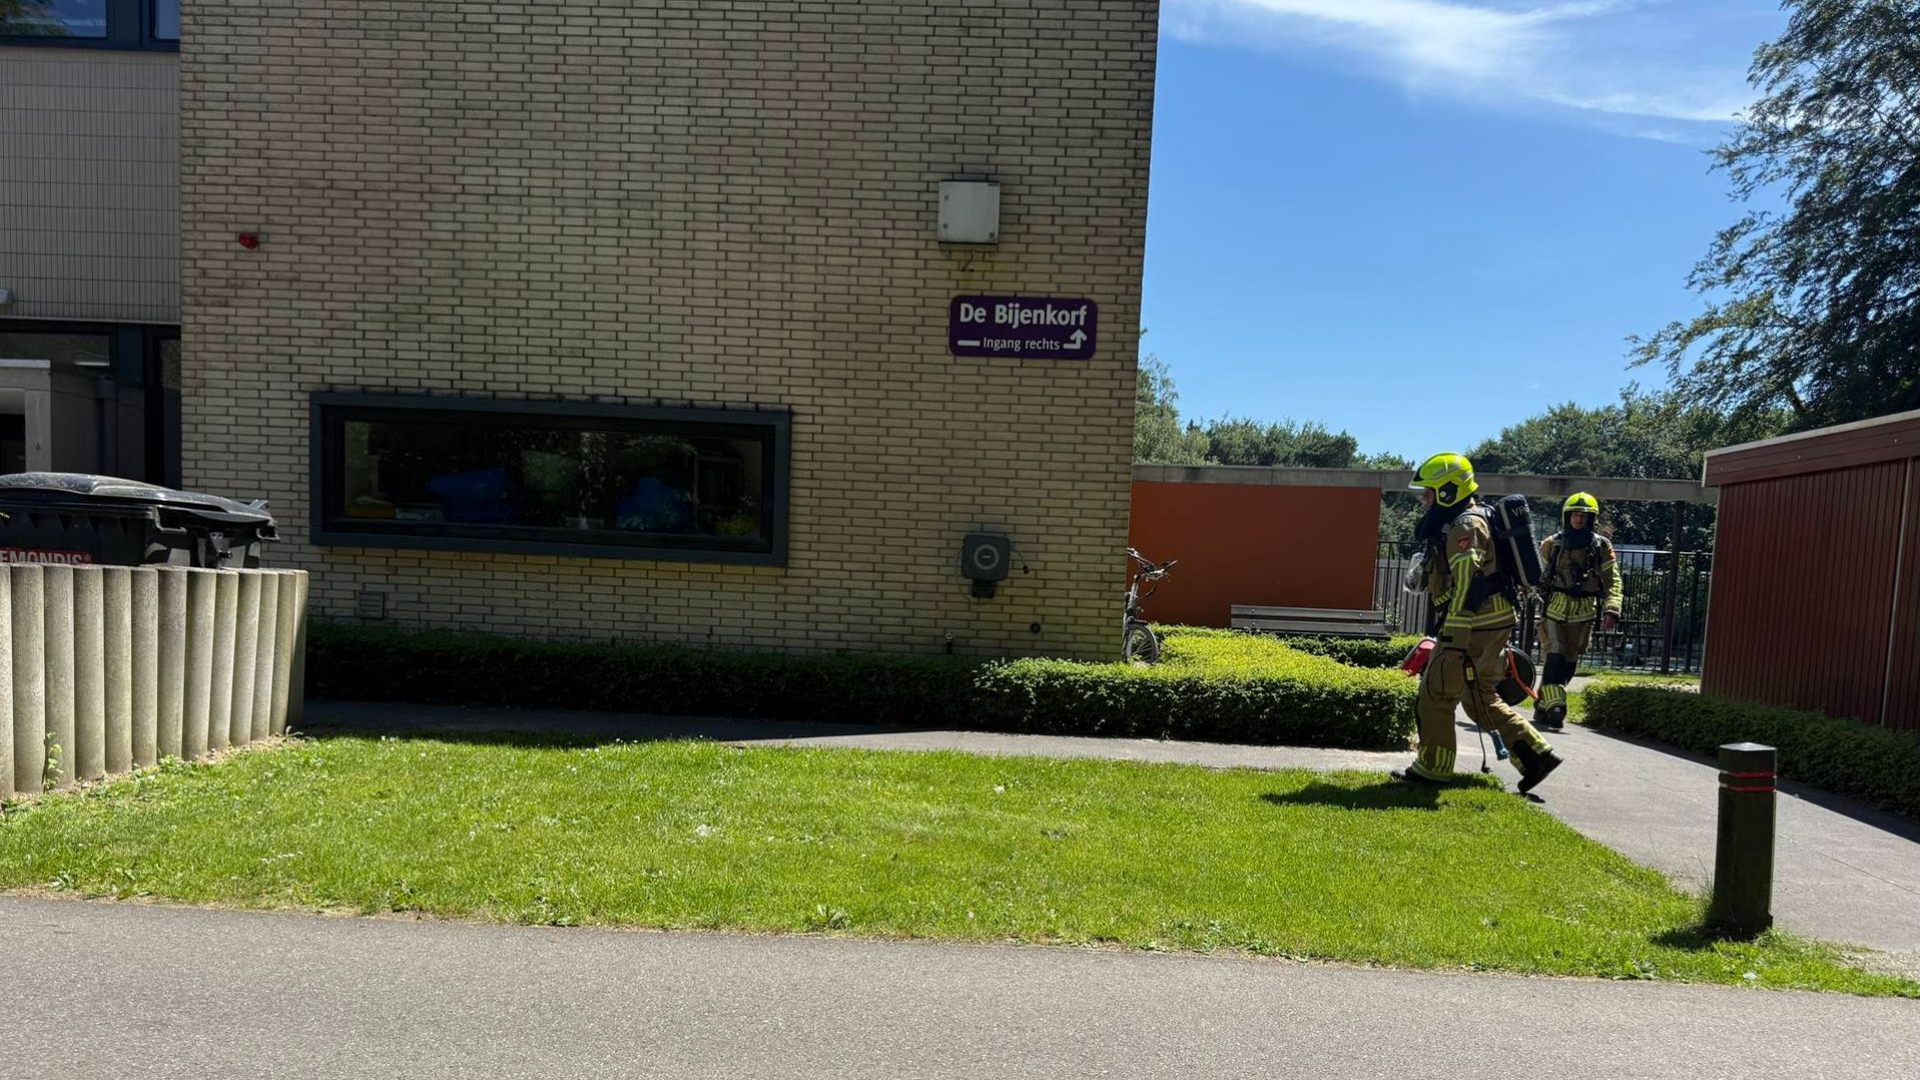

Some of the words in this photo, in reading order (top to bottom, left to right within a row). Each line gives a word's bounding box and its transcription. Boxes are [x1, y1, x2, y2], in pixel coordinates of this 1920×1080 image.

[960, 303, 987, 323] De
[995, 303, 1087, 328] Bijenkorf
[983, 337, 1021, 352] Ingang
[1025, 338, 1060, 350] rechts
[0, 550, 83, 564] EMONDIS
